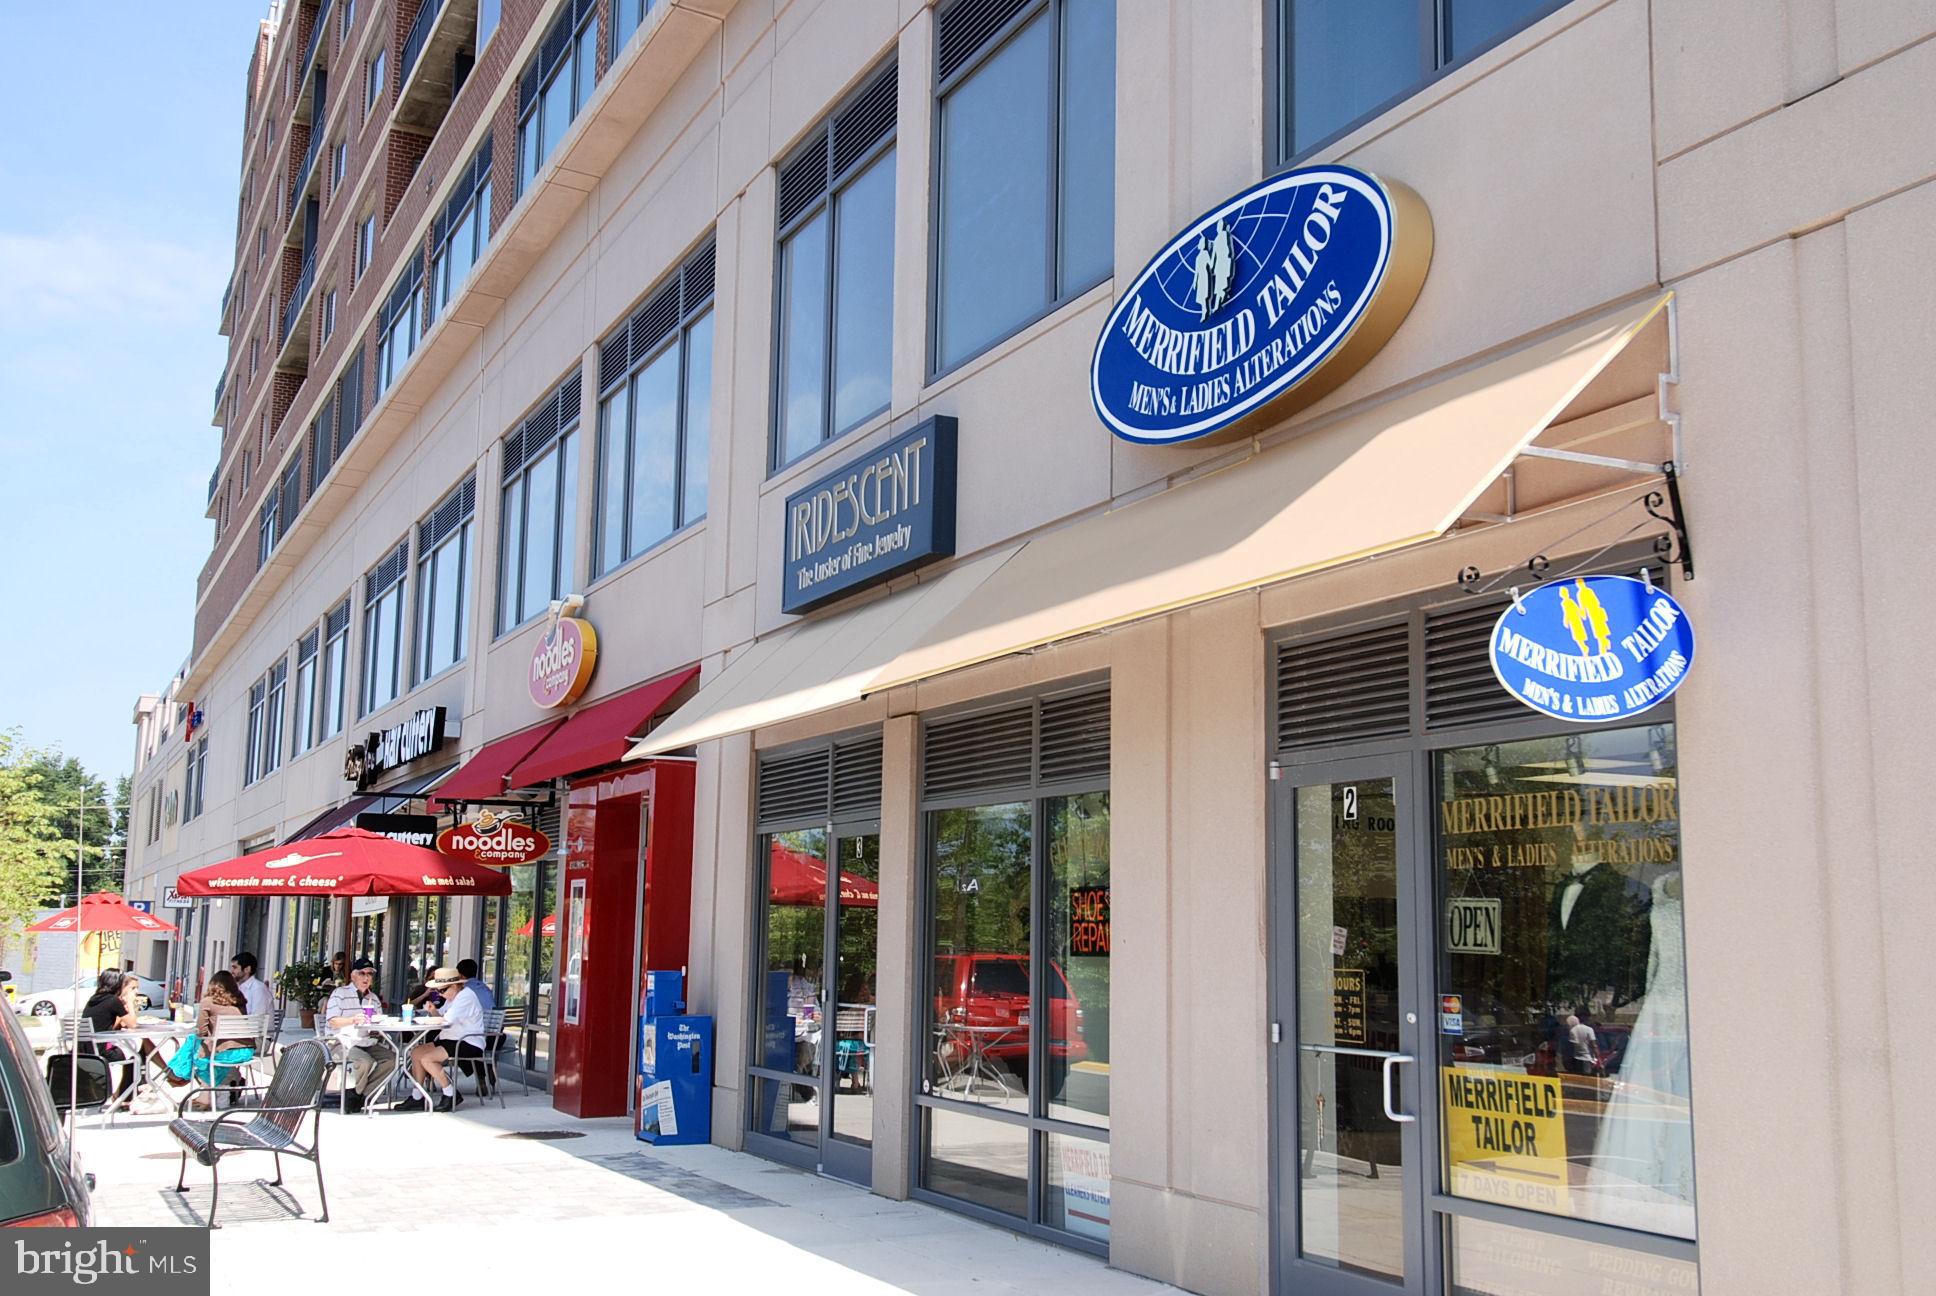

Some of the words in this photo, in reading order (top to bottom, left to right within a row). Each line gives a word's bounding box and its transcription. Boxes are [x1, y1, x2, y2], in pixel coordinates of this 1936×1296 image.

[1121, 294, 1256, 376] MERRIFIELD
[1256, 183, 1349, 330] TAILOR
[1128, 380, 1170, 416] MEN'S
[1170, 399, 1177, 414] &
[1179, 373, 1231, 416] LADIES
[1233, 279, 1342, 398] ALTERATIONS
[790, 437, 928, 563] IRIDESCENT
[797, 566, 813, 590] The
[814, 556, 841, 582] Luster
[841, 546, 852, 571] of
[852, 542, 873, 567] Fine
[873, 523, 912, 558] Jewelry
[533, 626, 576, 682] noodles
[1498, 627, 1624, 683] MERRIFIELD
[1621, 597, 1681, 662] TAILOR
[1522, 677, 1560, 710] MEN'S
[1562, 694, 1573, 714] &
[1623, 649, 1688, 709] ALTERATIONS
[1345, 788, 1355, 818] 2
[1442, 790, 1582, 835] MERRIFIELD
[1585, 782, 1677, 826] TAILOR
[452, 828, 536, 852] noodles
[1447, 847, 1484, 869] MEN'S
[1491, 845, 1501, 867] &
[1507, 843, 1557, 866] LADIES
[1571, 837, 1673, 864] ALTERATIONS
[208, 876, 260, 888] wisconsin
[261, 878, 285, 888] mac
[287, 875, 298, 887] &
[421, 874, 437, 886] the
[437, 875, 455, 886] med
[455, 875, 475, 887] salad
[1450, 905, 1496, 947] OPEN
[667, 1032, 701, 1041] Washington
[1444, 1017, 1460, 1027] VISA
[677, 1041, 691, 1051] Post
[1448, 1074, 1557, 1119] MERRIFIELD
[1471, 1115, 1538, 1157] TAILOR
[1460, 1173, 1469, 1190] 7
[1474, 1176, 1510, 1198] DAYS
[1515, 1182, 1558, 1206] OPEN
